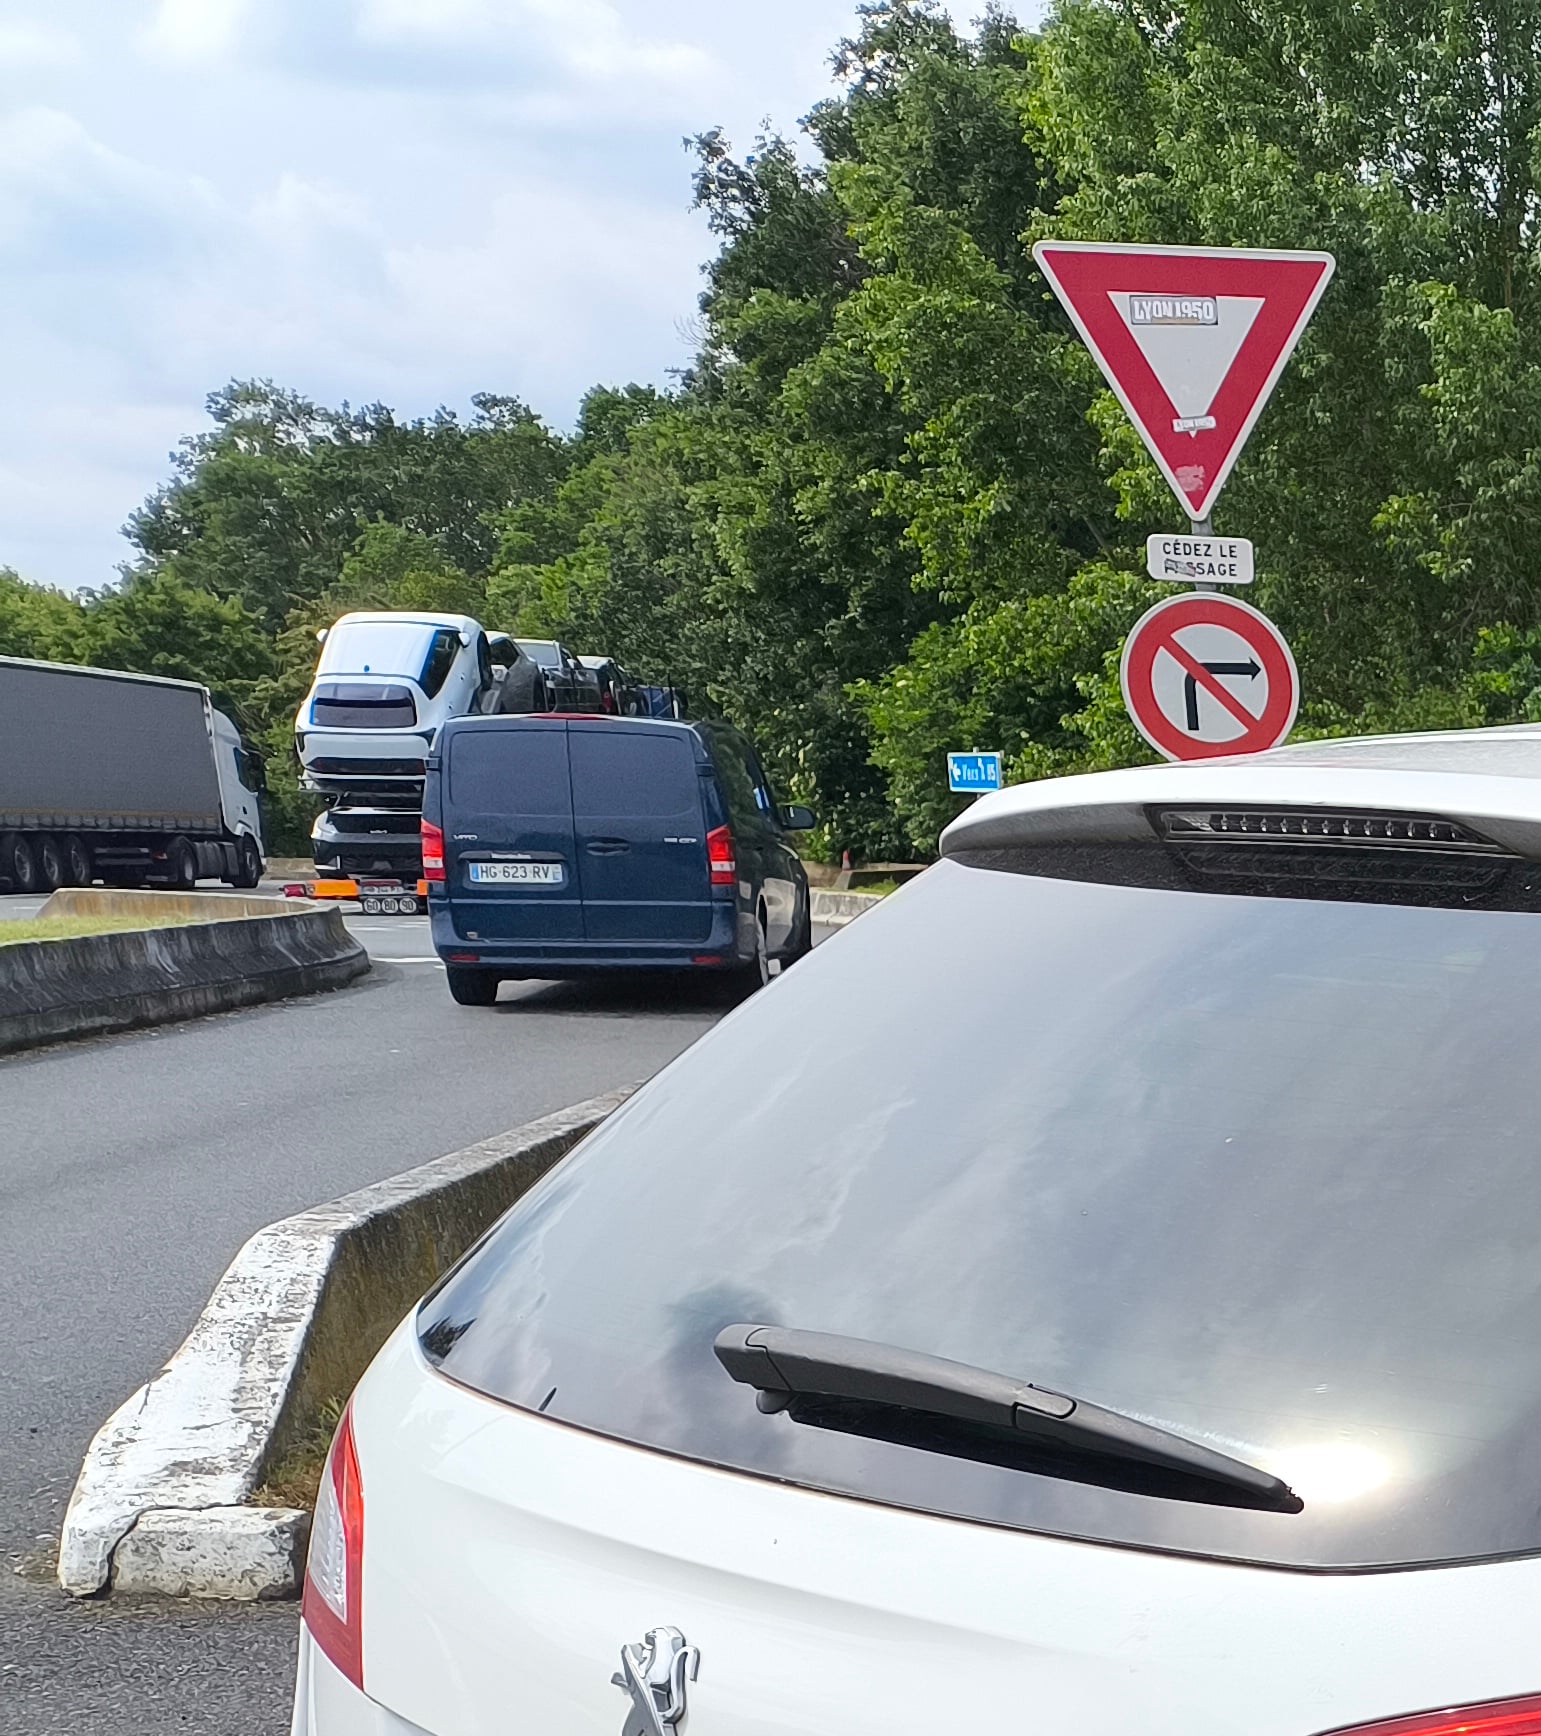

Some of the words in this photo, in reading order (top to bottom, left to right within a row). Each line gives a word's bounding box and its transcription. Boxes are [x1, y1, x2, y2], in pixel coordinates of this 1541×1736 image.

[1133, 301, 1173, 320] LYON
[1174, 301, 1214, 320] 1950
[1162, 538, 1213, 557] CÉDEZ
[1219, 544, 1238, 558] LE
[366, 899, 378, 912] 60
[383, 899, 396, 912] 80
[401, 899, 414, 912] 90
